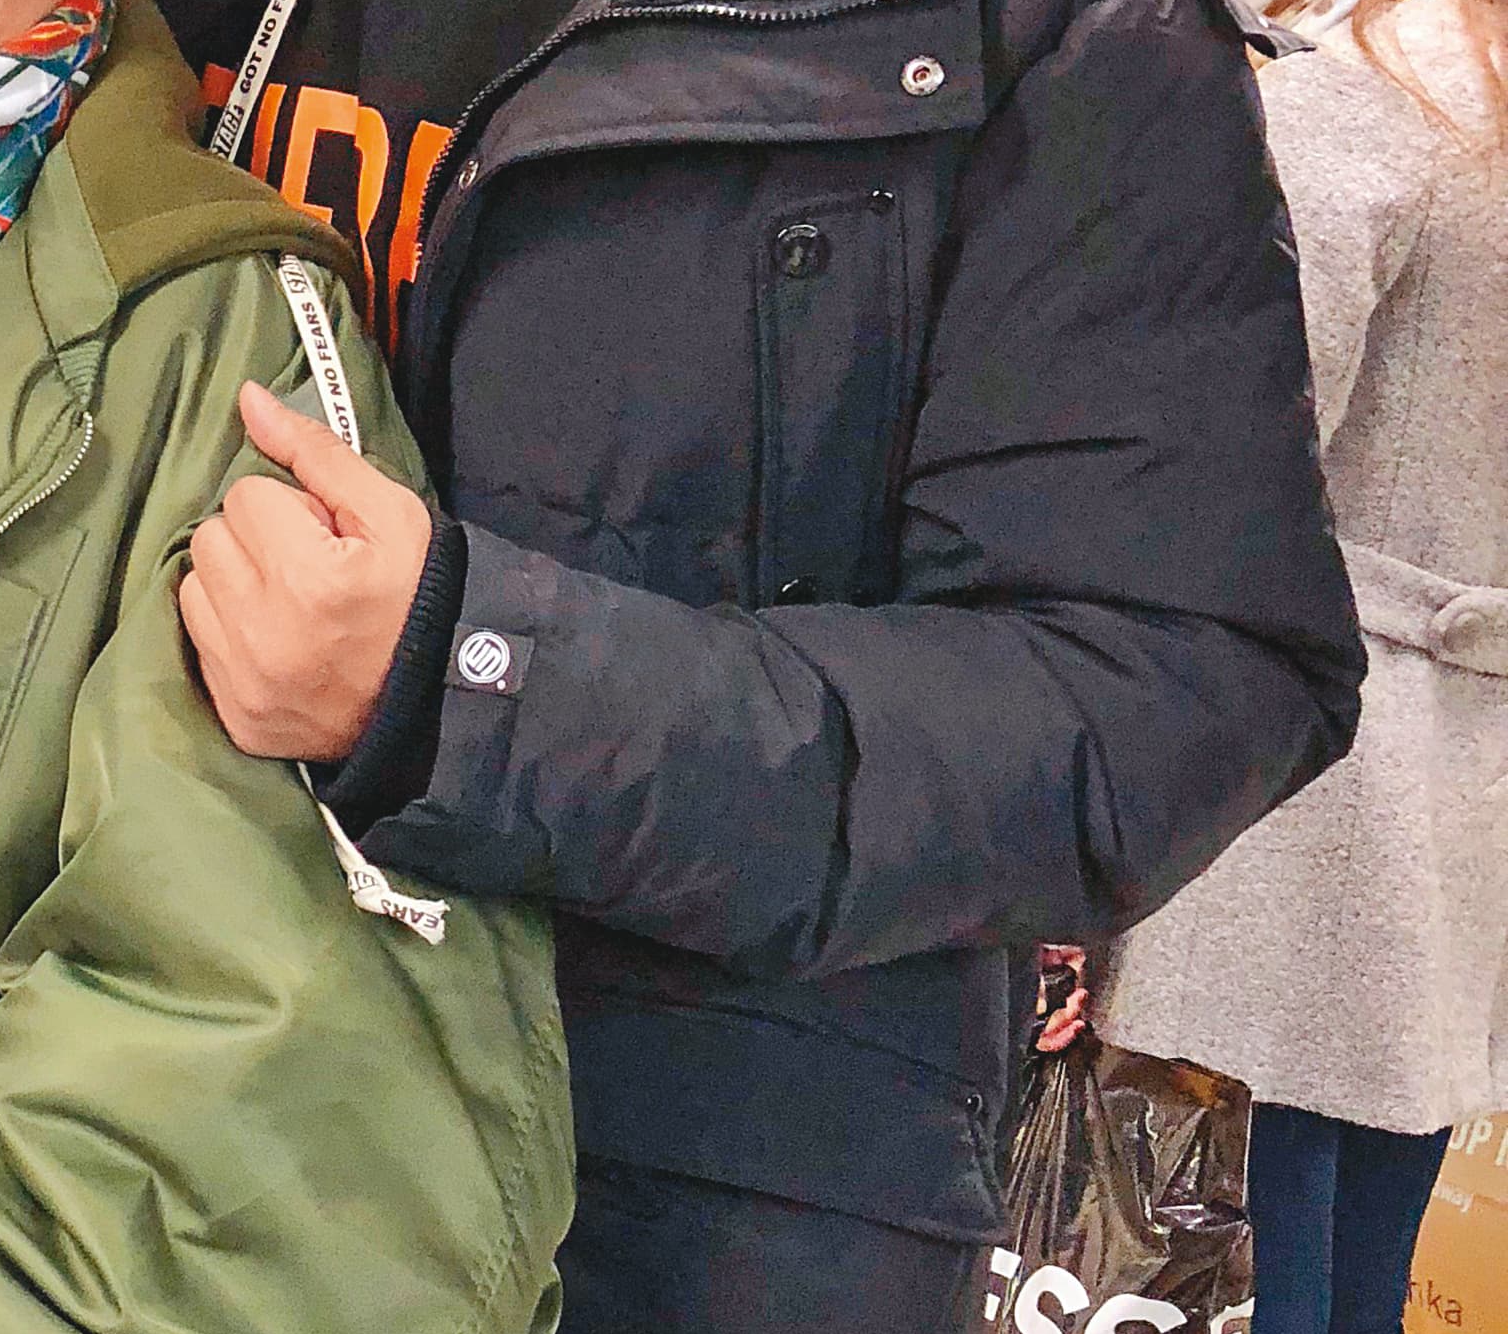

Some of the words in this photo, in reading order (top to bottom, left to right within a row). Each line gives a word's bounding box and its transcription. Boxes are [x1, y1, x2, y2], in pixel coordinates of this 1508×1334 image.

[240, 54, 263, 94] GOT
[258, 18, 277, 48] NO
[302, 302, 333, 362] FEARS
[324, 368, 344, 397] NO
